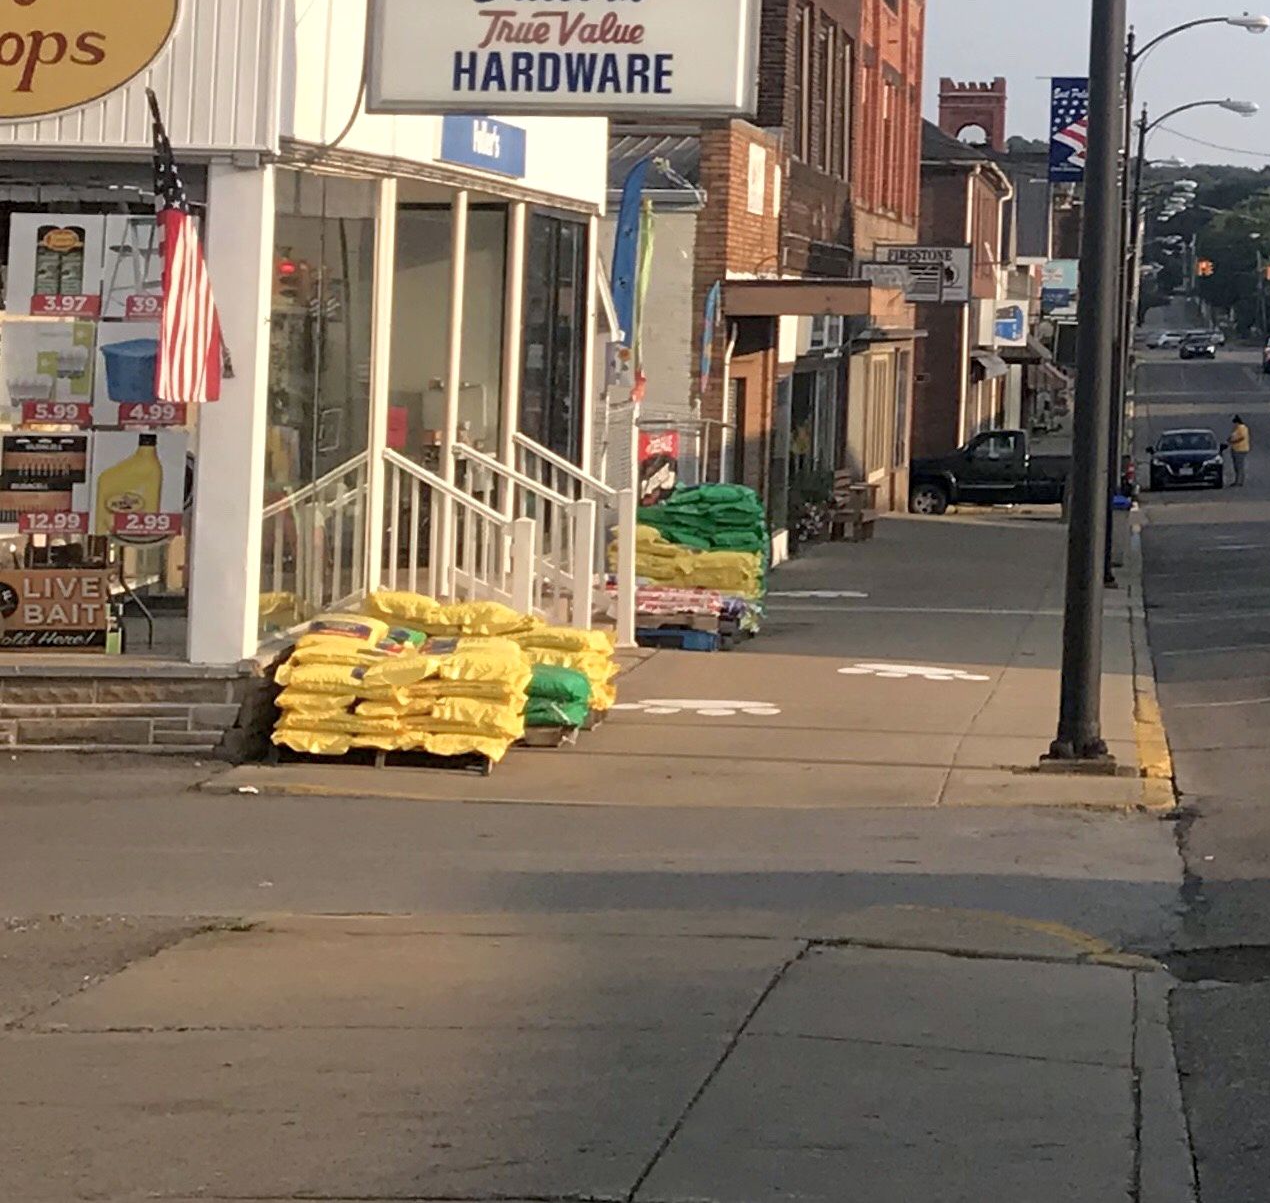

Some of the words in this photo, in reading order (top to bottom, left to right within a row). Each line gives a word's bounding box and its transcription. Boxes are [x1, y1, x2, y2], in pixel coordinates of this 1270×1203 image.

[477, 9, 551, 49] True
[532, 10, 646, 47] Value
[452, 49, 674, 94] HARDWARE
[887, 248, 954, 262] FIRESTONE
[43, 296, 88, 312] 3.97
[132, 297, 162, 313] 39.
[34, 403, 79, 420] 5.99
[129, 403, 176, 420] 4.99
[27, 513, 81, 530] 12.99
[126, 513, 171, 531] 2.99
[23, 577, 100, 599] LIVE
[23, 603, 101, 625] BAIT
[38, 630, 97, 646] Here!
